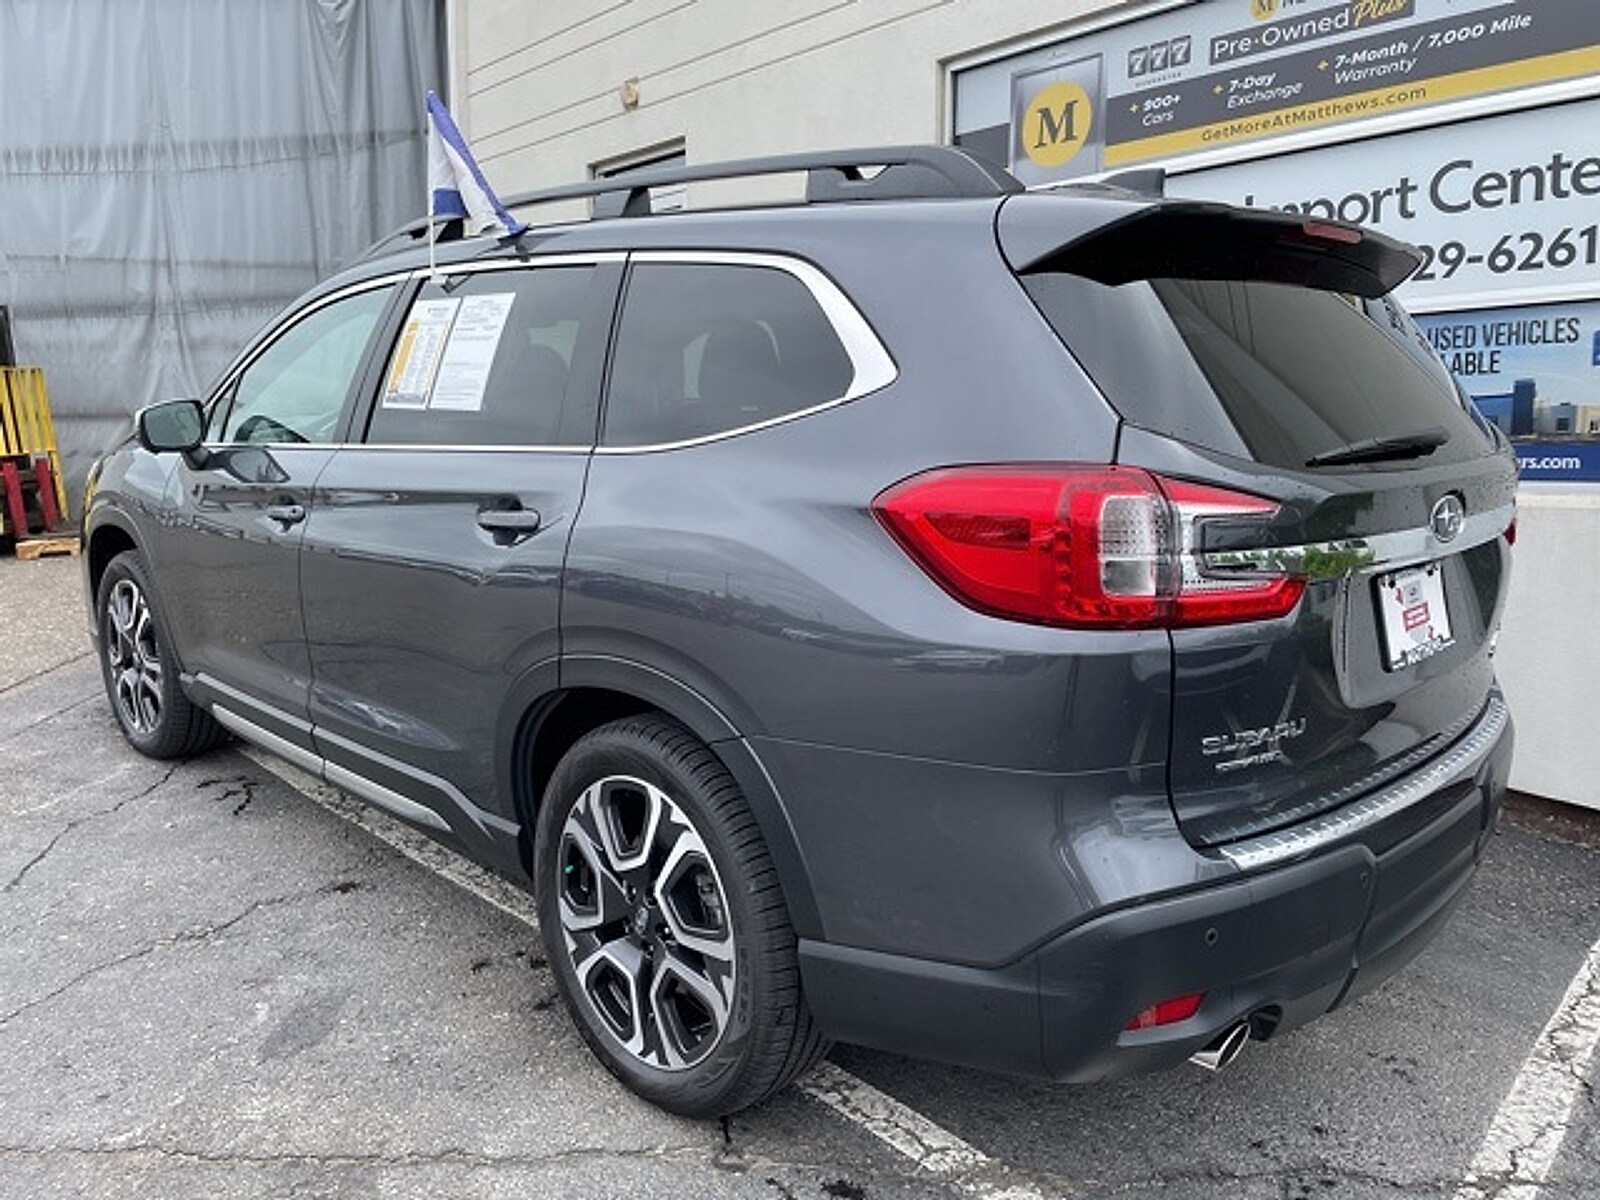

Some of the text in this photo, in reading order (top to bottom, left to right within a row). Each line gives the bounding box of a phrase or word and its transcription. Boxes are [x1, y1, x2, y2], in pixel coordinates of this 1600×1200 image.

[1490, 14, 1532, 34] Mile
[1335, 56, 1418, 85] Warranty
[1227, 82, 1304, 108] Exchange
[1034, 100, 1079, 149] M
[1201, 86, 1427, 142] GetMoreAtMatthews.com
[1428, 318, 1580, 351] USED VEHICLES
